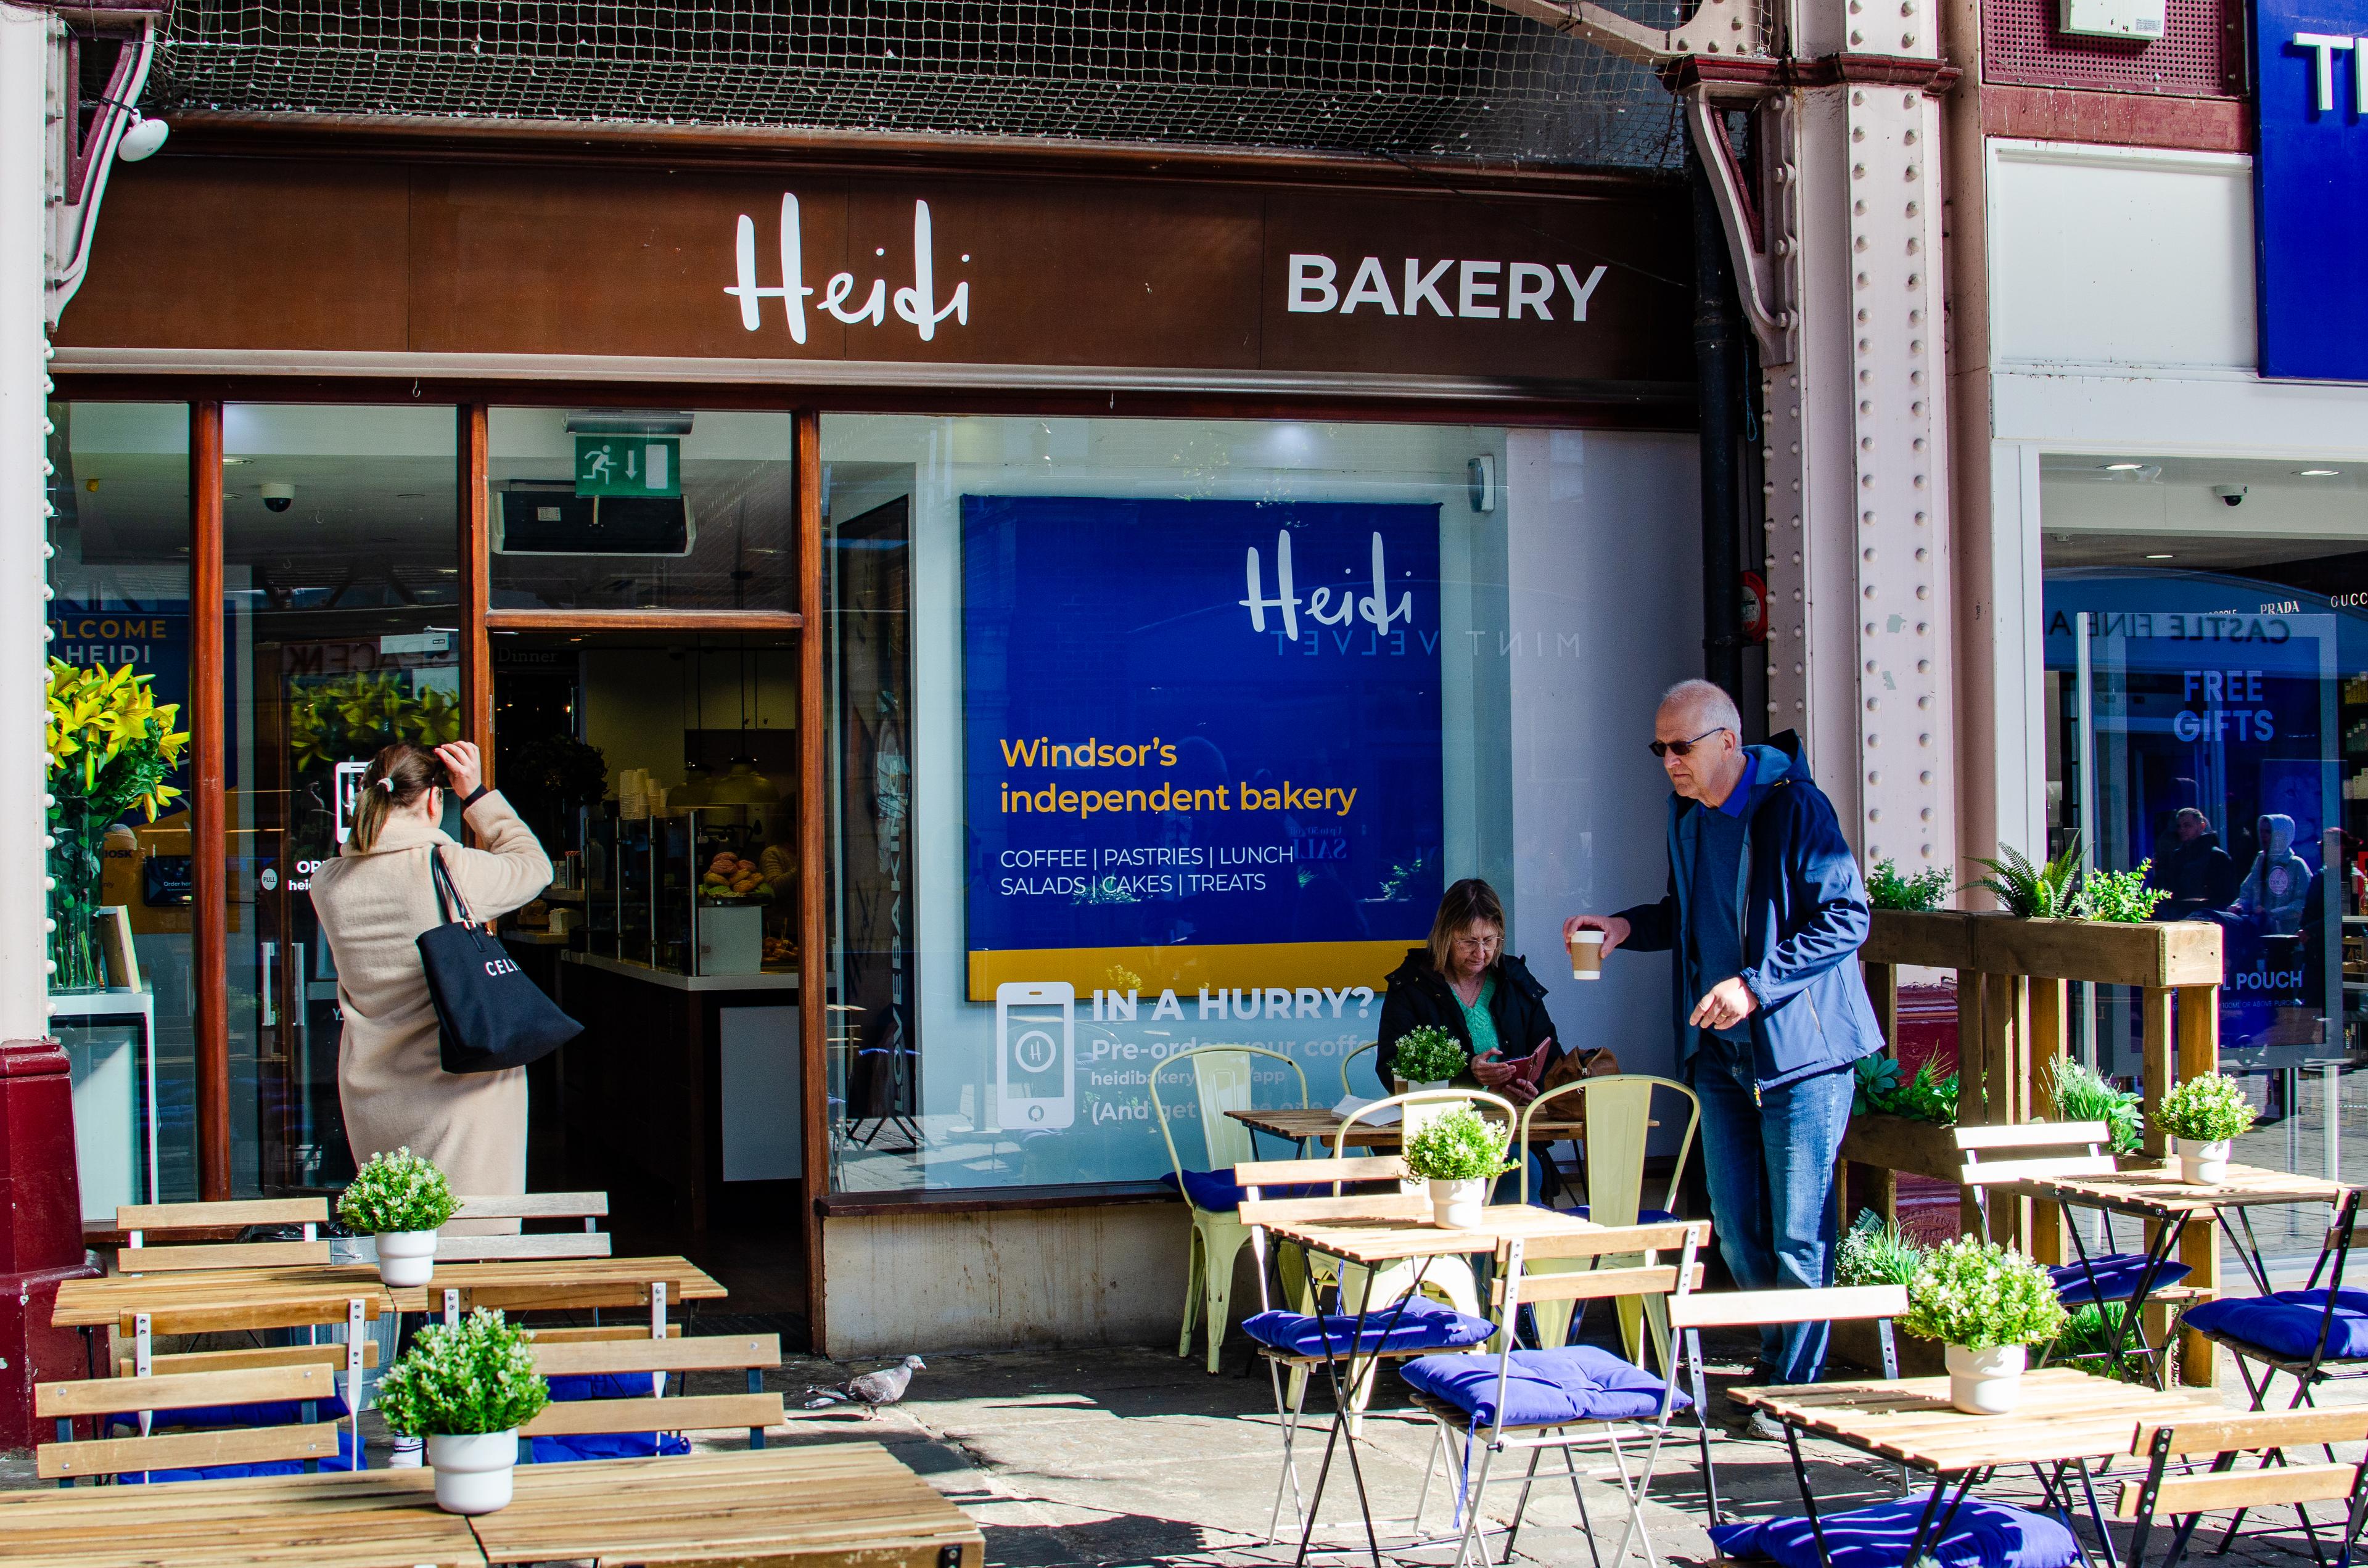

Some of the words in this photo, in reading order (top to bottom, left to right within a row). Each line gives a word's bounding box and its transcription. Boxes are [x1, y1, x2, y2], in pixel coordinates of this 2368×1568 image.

[2293, 32, 2368, 113] T
[723, 192, 970, 345] Heidi
[1288, 253, 1608, 321] BAKERY
[1238, 530, 1412, 641] Heidi
[2260, 601, 2300, 614] PRADA
[2330, 592, 2368, 607] GUCC
[48, 620, 167, 639] LCOME
[65, 645, 150, 663] HEIDI
[497, 647, 558, 663] Dinner
[2184, 670, 2263, 702] FREE
[2173, 709, 2274, 742] GIFTS
[1001, 782, 1230, 819] independent
[1240, 781, 1357, 816] bakery
[1000, 850, 1088, 868] COFFEE
[1104, 847, 1203, 866] PASTRIES
[1220, 846, 1294, 865] LUNCH
[1001, 876, 1087, 895] SALADS
[1102, 875, 1173, 893] CAKES
[1190, 874, 1266, 892] TREATS
[2236, 971, 2303, 990] POUCH
[1093, 989, 1138, 1022] IN
[1151, 988, 1186, 1021] A
[1199, 987, 1375, 1020] HURRY?
[1304, 1034, 1379, 1057] coffe
[1092, 1099, 1149, 1125] (And
